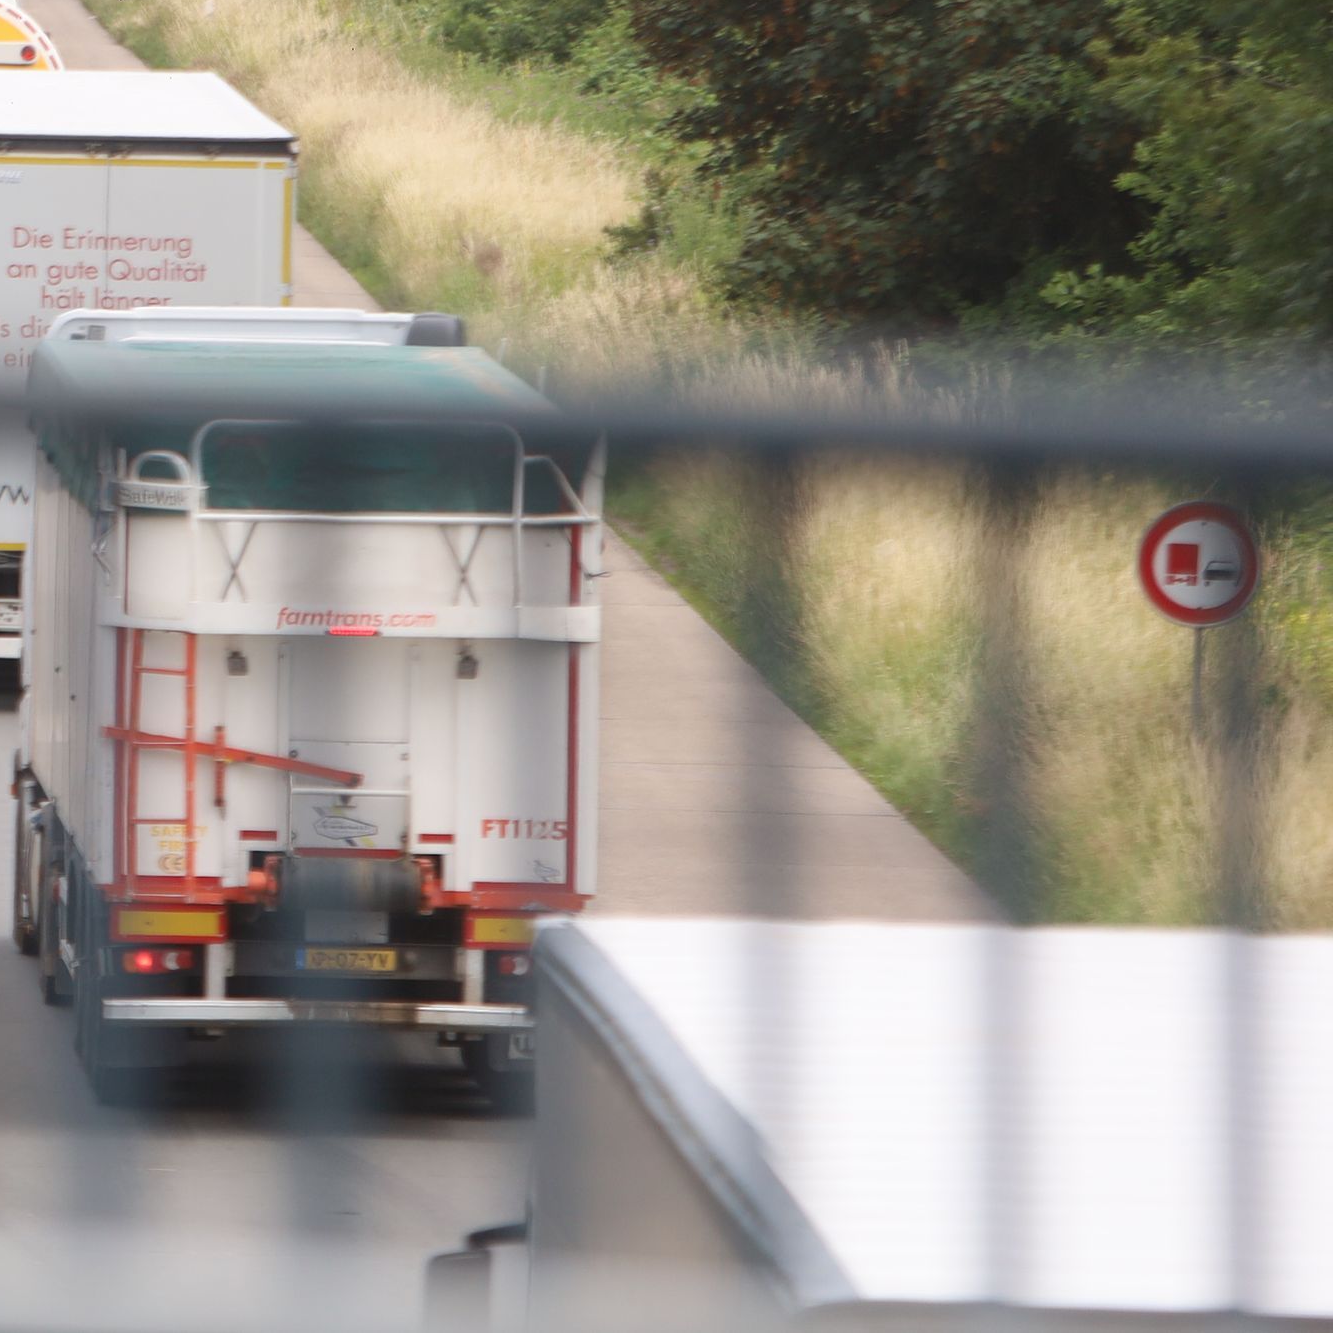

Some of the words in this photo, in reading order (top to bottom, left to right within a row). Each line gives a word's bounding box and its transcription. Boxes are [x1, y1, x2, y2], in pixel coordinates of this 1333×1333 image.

[12, 226, 54, 249] Die
[63, 227, 193, 259] Erinnerung
[6, 263, 38, 279] an
[46, 262, 99, 286] gute
[107, 258, 207, 283] Qualität
[40, 286, 85, 309] hält
[94, 286, 173, 310] länger
[480, 818, 569, 841] FT1125
